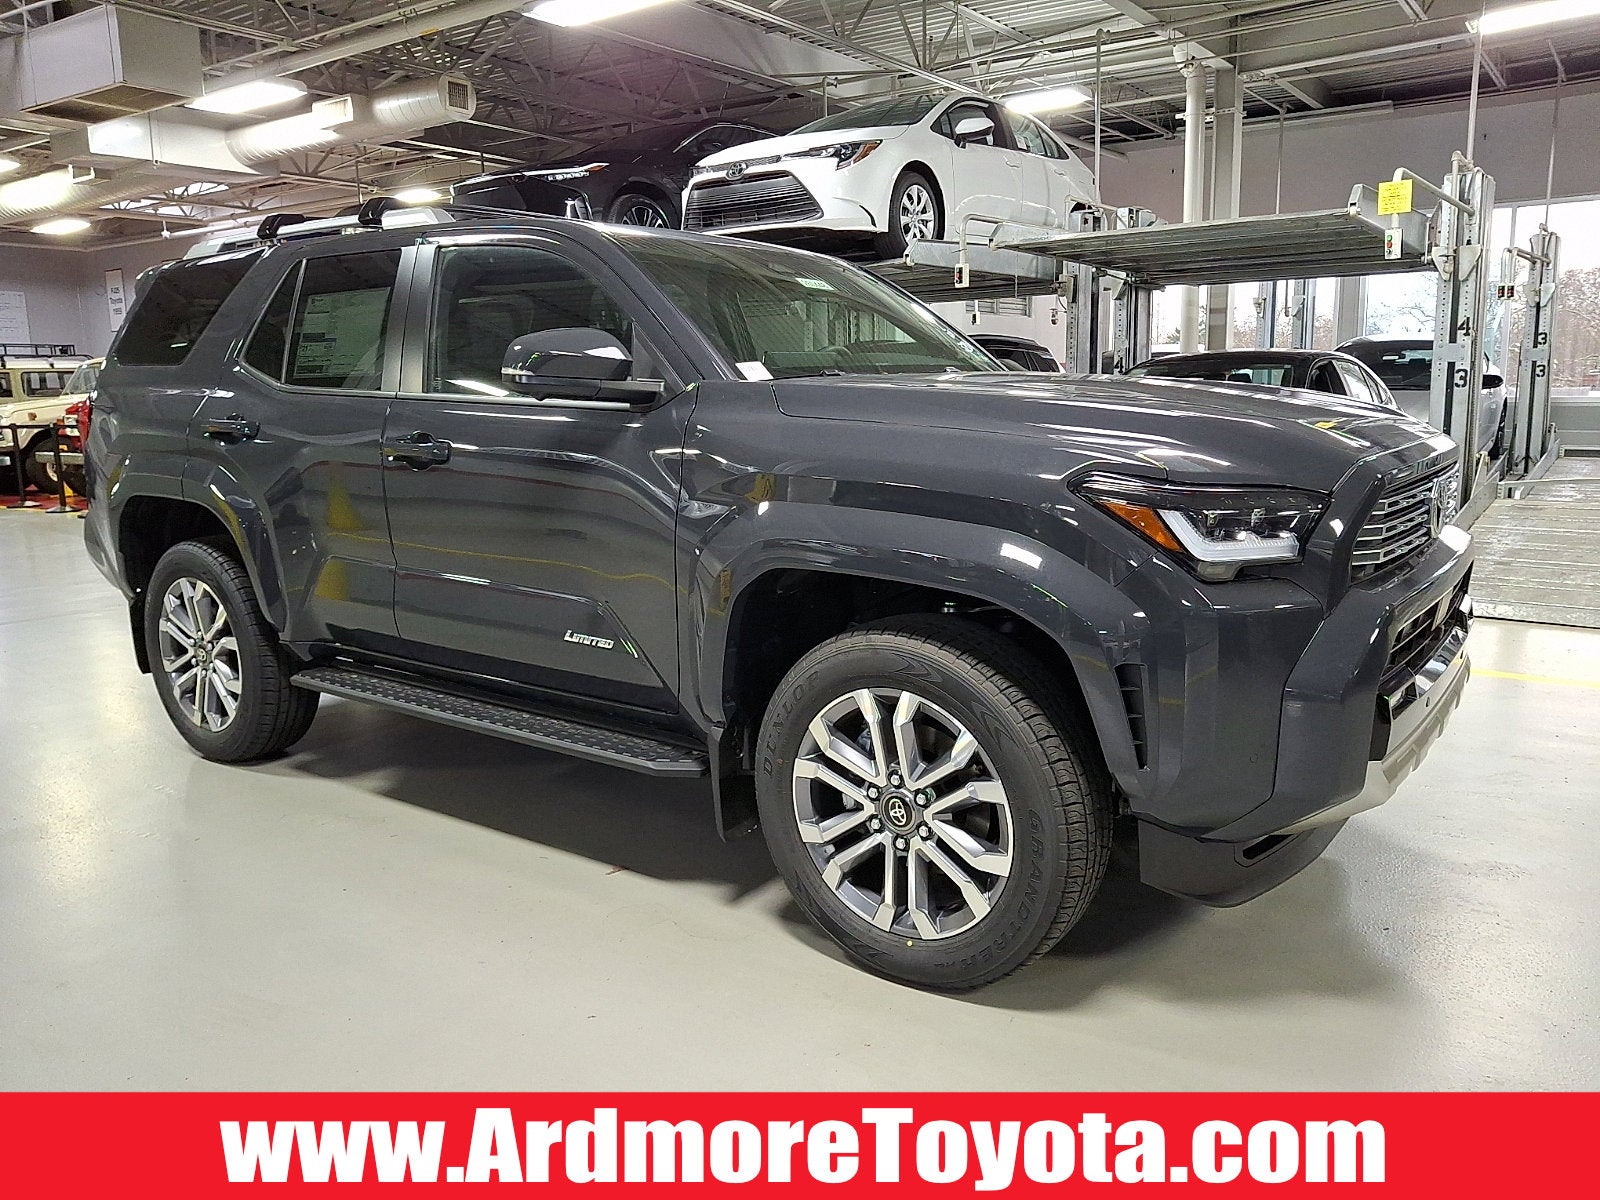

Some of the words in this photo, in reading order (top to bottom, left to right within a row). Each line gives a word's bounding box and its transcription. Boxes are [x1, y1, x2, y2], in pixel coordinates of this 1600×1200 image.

[1457, 316, 1471, 337] 4
[1538, 332, 1548, 346] 3
[1454, 368, 1469, 388] 3
[1536, 364, 1546, 378] 3
